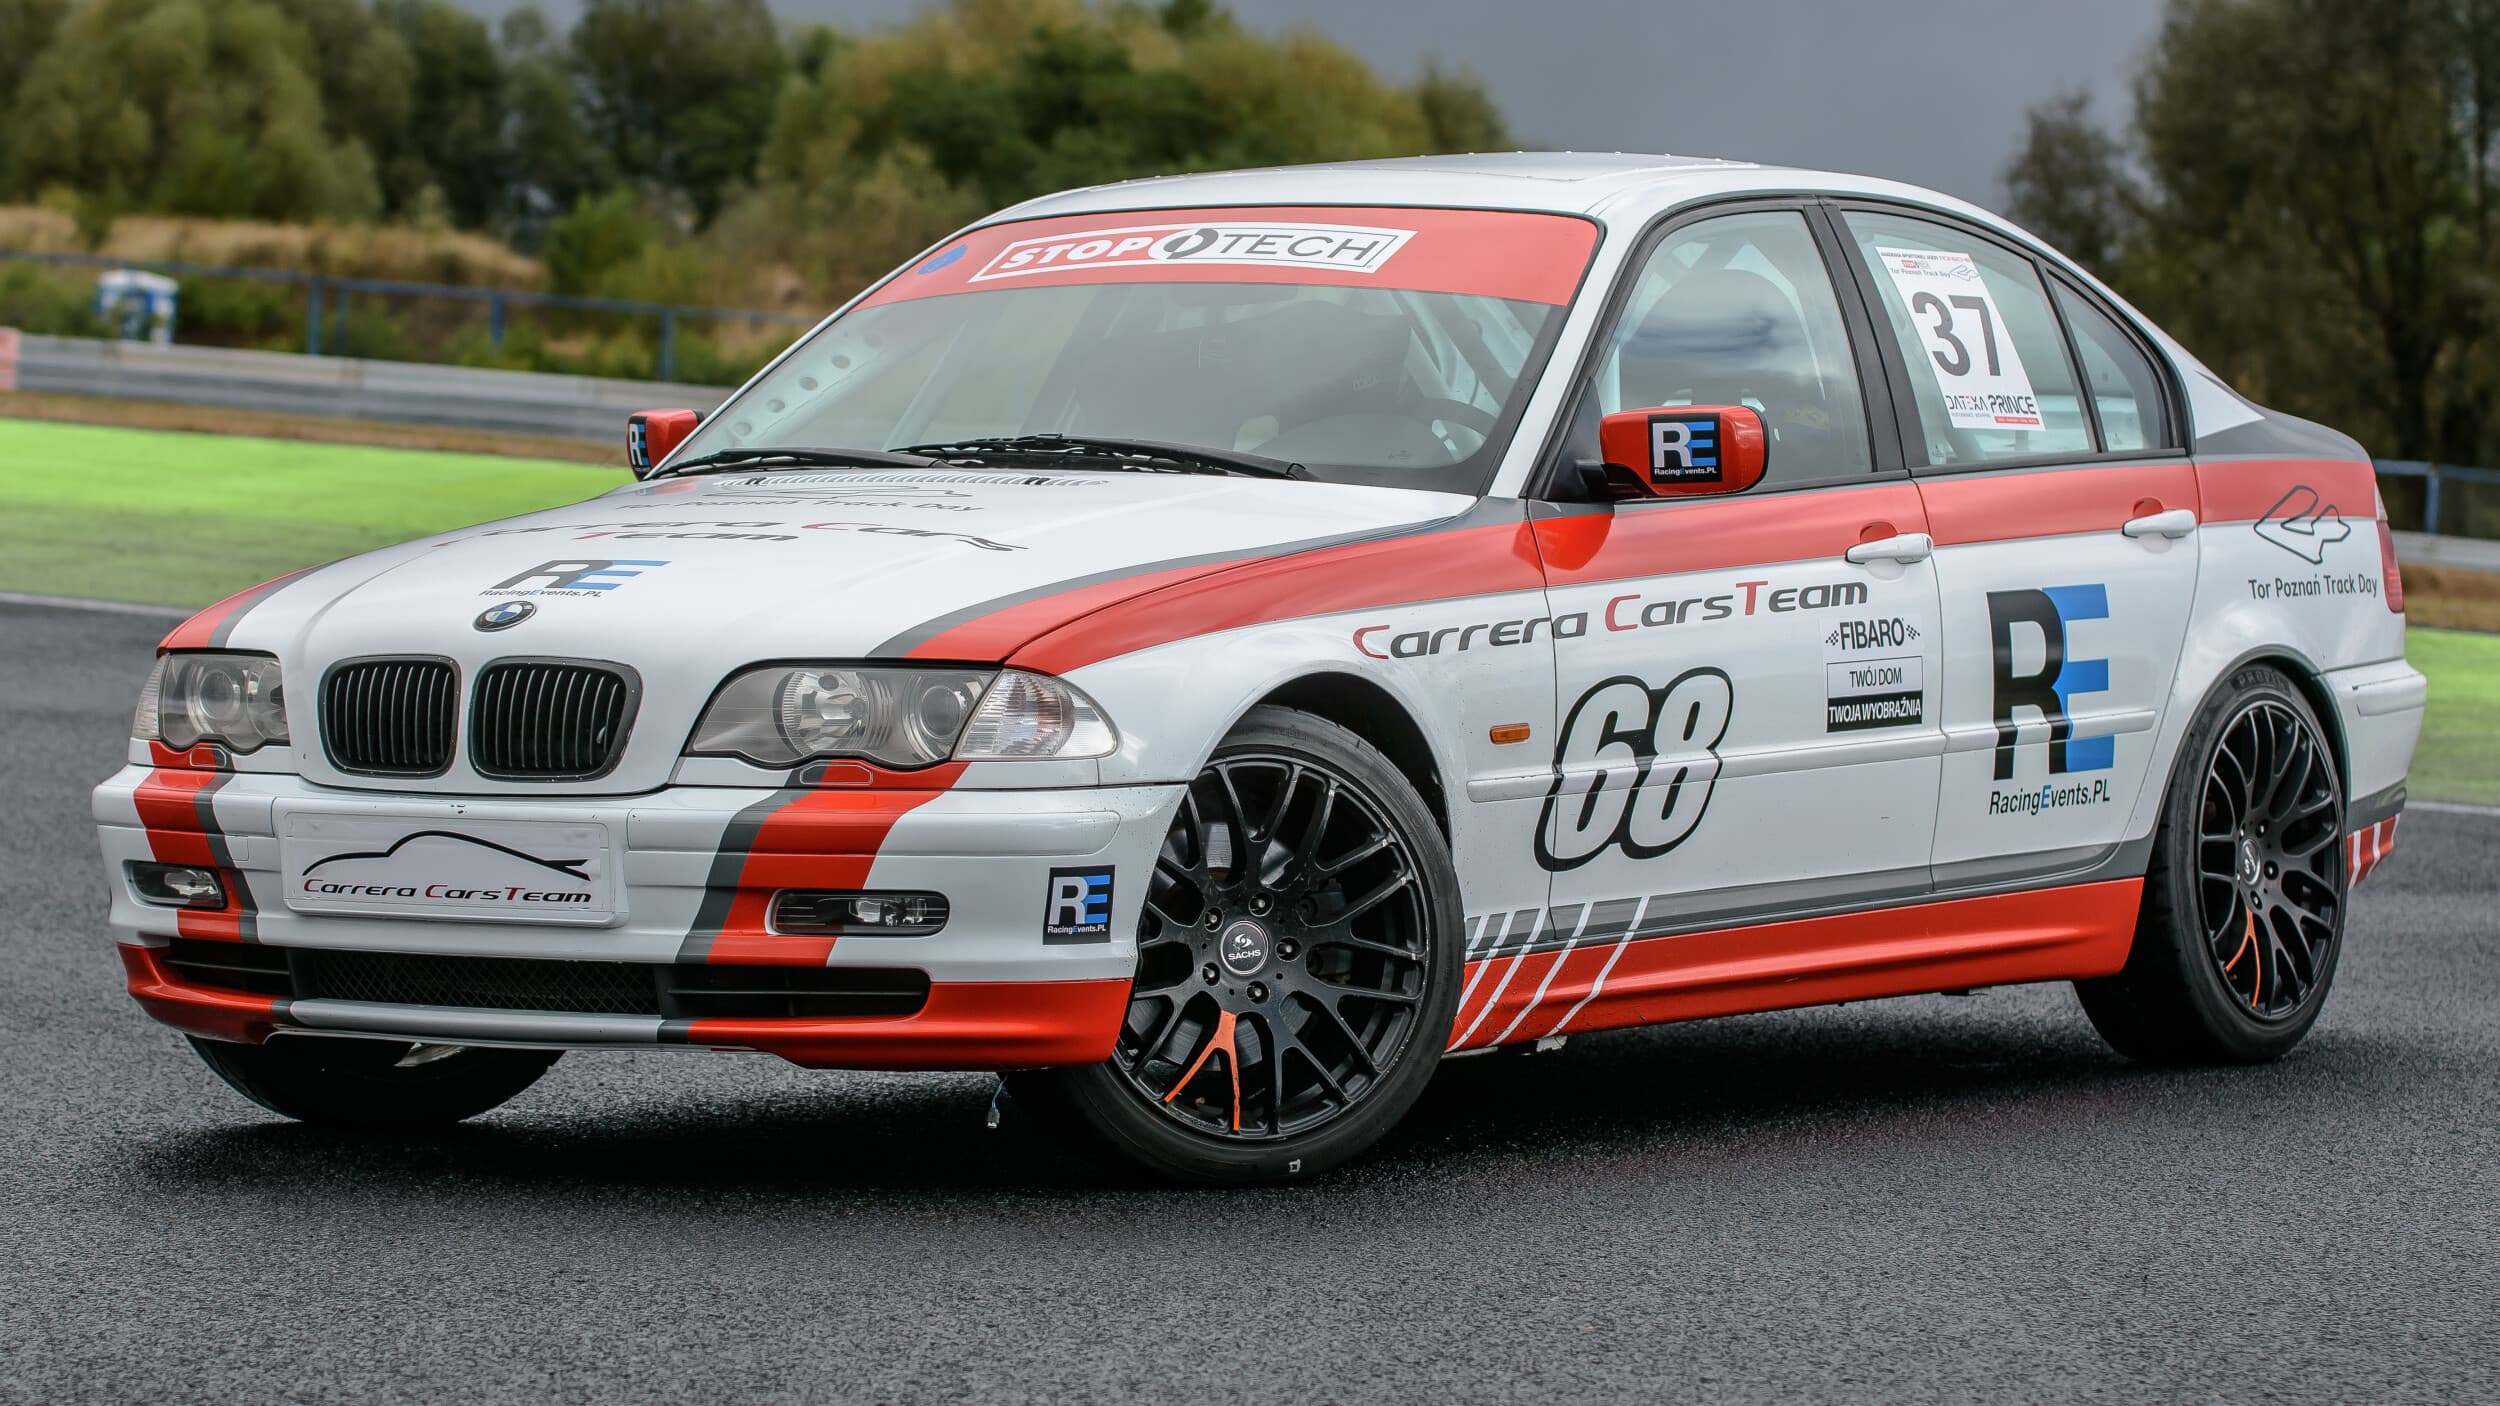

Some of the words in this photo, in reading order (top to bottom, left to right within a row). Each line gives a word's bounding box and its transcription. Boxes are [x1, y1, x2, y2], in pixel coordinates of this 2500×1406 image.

[1912, 291, 2001, 377] 37
[1988, 394, 2037, 415] PRINCE
[1652, 421, 1717, 468] RE
[812, 500, 908, 508] Track
[912, 502, 985, 512] Day
[572, 530, 800, 542] Team
[489, 558, 673, 591] RE
[2247, 579, 2271, 600] Tor
[2275, 573, 2321, 598] Poznań
[2323, 573, 2356, 595] Track
[2358, 572, 2378, 599] Day
[478, 588, 602, 599] RacingEvents.PL
[1352, 612, 1589, 660] Carrera
[1840, 617, 1905, 651] FIBARO
[1849, 665, 1877, 689] TWÓJ
[1878, 666, 1903, 686] DOM
[1986, 583, 2115, 781] RE
[1828, 703, 1862, 724] TWOJA
[1862, 696, 1922, 720] WYOBRAŹNIA
[1533, 665, 1734, 872] 68
[1988, 778, 2111, 816] RacingEvents.PL
[303, 878, 418, 898] Carrera
[1048, 874, 1111, 925] RE
[1047, 924, 1107, 935] RacingEvents.PL
[1227, 949, 1262, 961] SACHS
